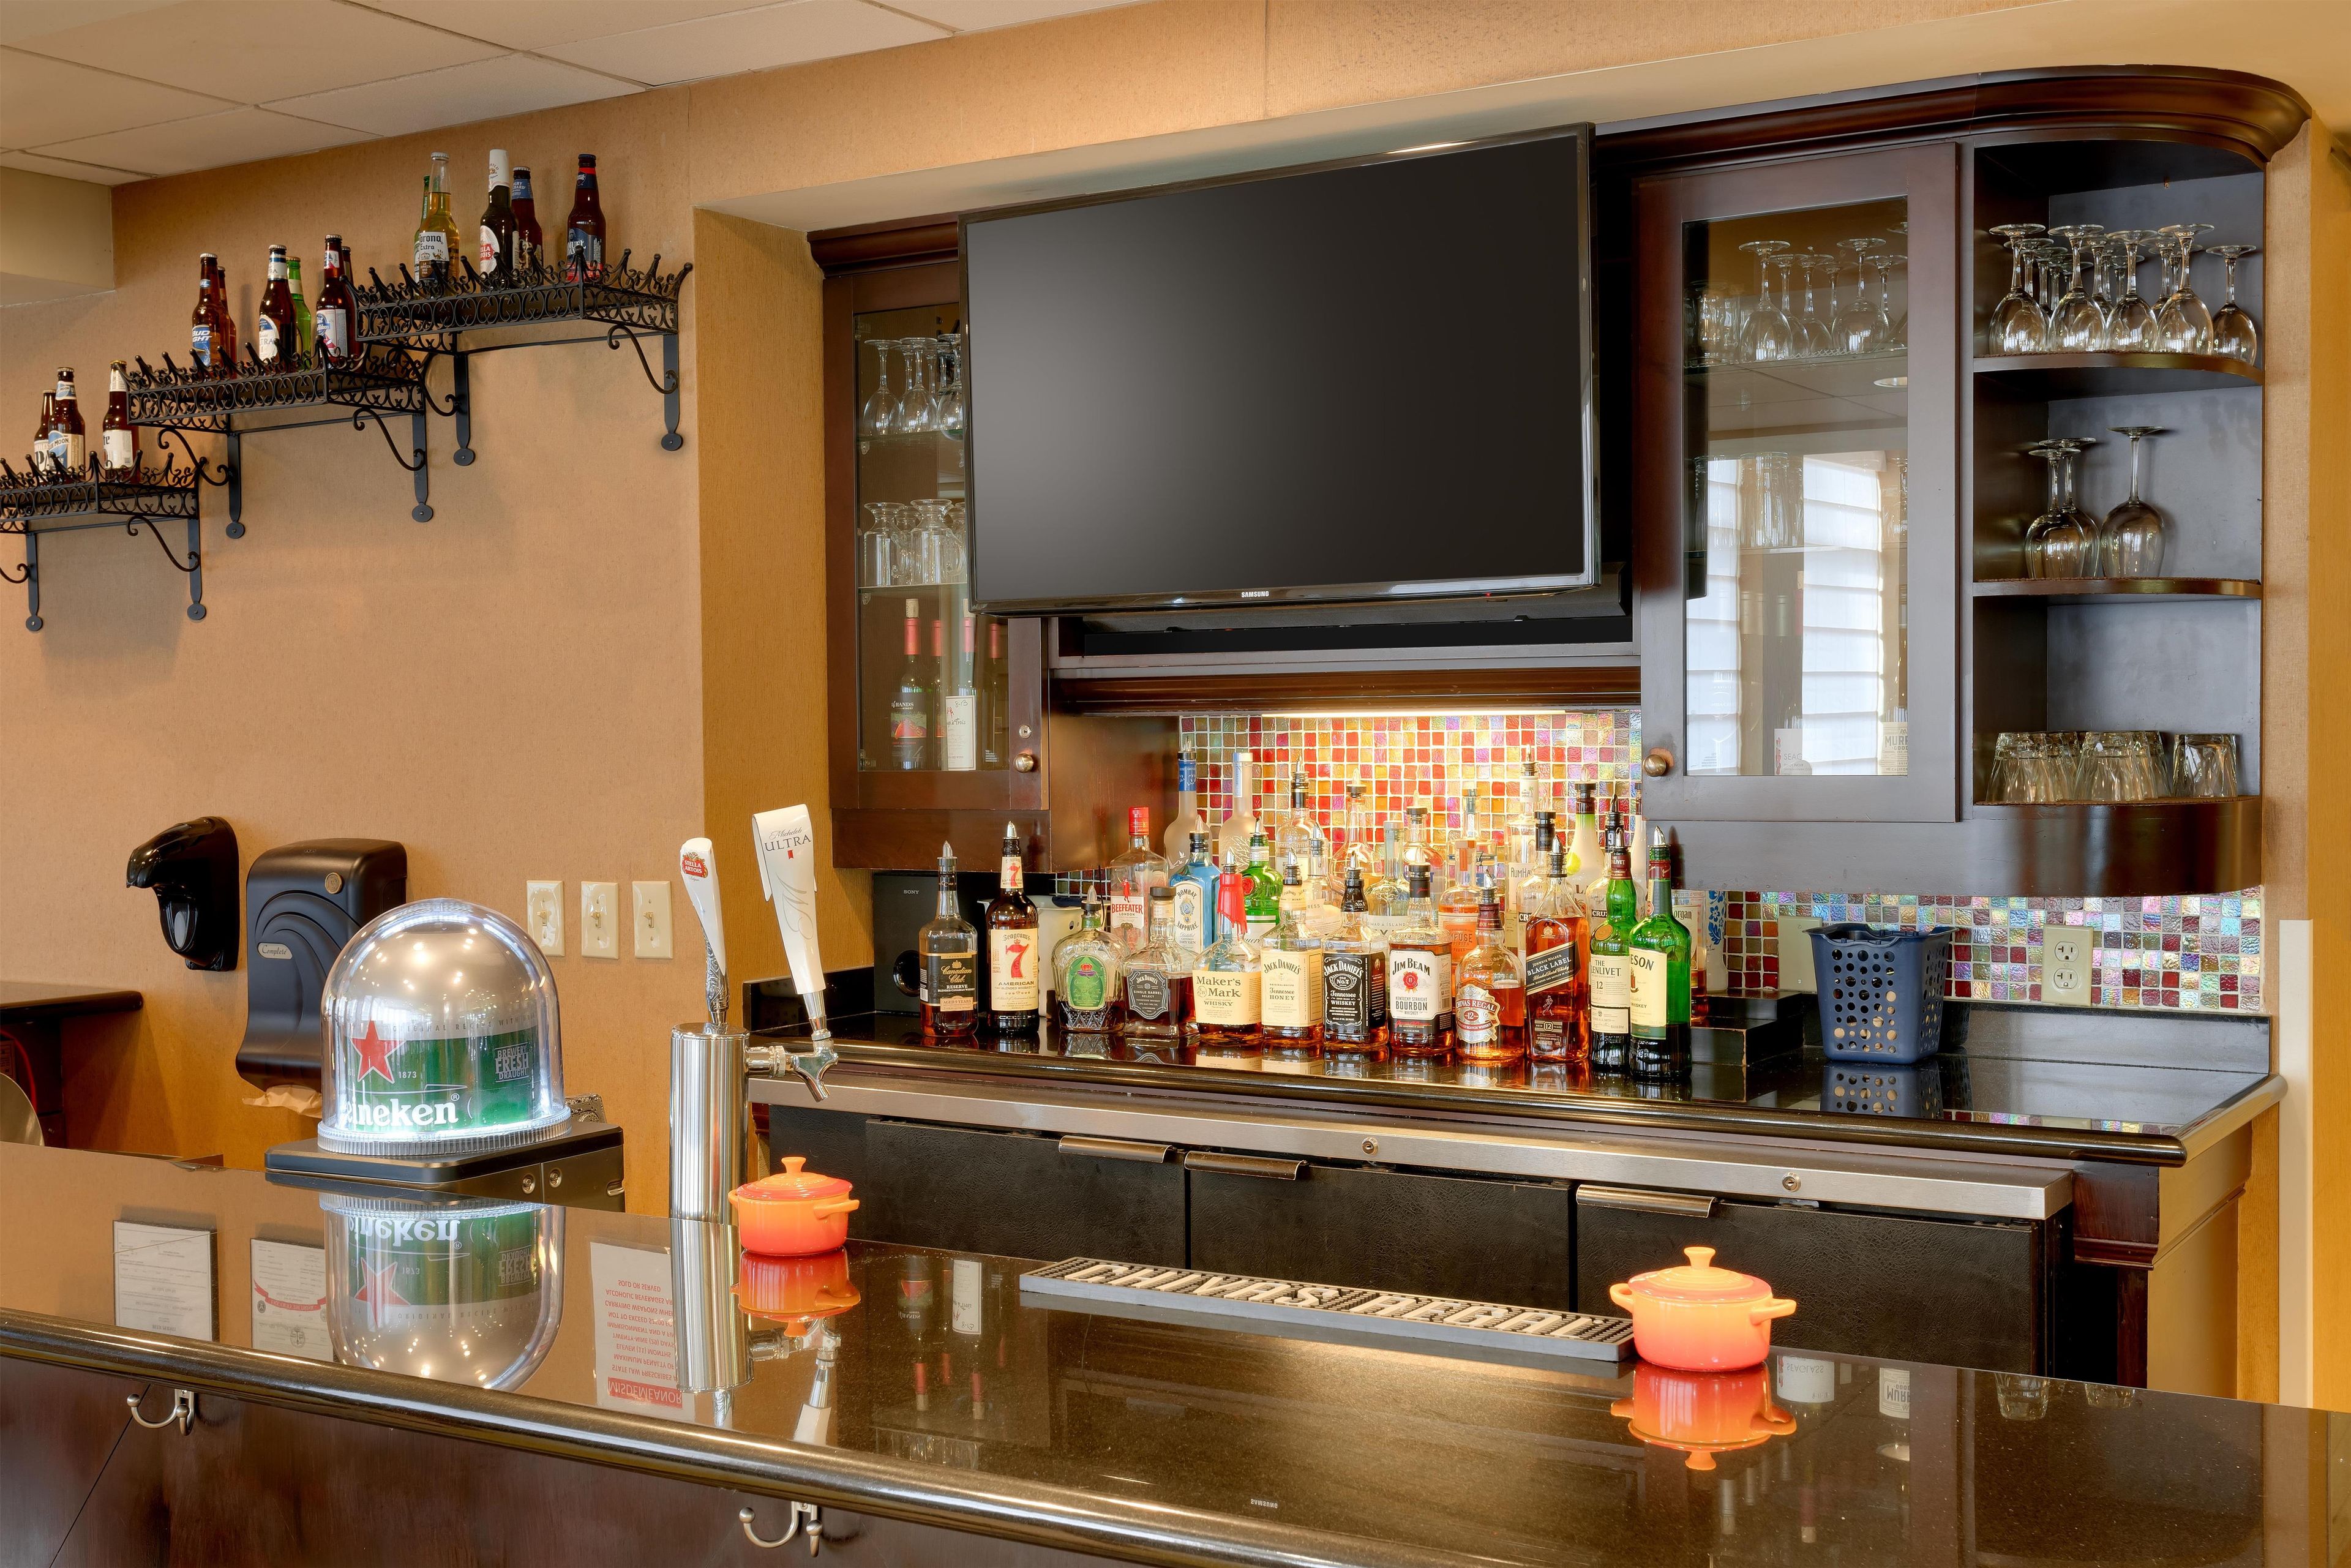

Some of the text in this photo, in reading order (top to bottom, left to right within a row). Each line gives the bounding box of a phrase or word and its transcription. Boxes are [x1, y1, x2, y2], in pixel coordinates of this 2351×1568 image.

[769, 827, 803, 841] Michelob
[764, 835, 811, 852] ULTRA
[684, 866, 703, 874] ARTOIS
[1177, 888, 1198, 899] BOMBAY
[1112, 904, 1143, 914] BEEFEATER
[1673, 910, 1692, 920] organ
[1176, 921, 1199, 931] SAPPHIRE
[261, 945, 287, 956] Complete
[1005, 943, 1029, 978] 7
[1527, 957, 1572, 976] BLACK LABEL
[1532, 959, 1548, 967] JOHNNIE
[941, 966, 973, 975] Canadian
[1264, 959, 1302, 975] JACK DANIEL'S
[1324, 961, 1363, 978] JACK DANIEL'S
[1392, 958, 1431, 976] JIM BEAM
[1196, 976, 1241, 986] Maker's
[1596, 981, 1603, 989] 12
[1209, 988, 1241, 997] Mark
[1396, 1001, 1427, 1010] BOURBON
[1472, 999, 1496, 1011] REGAL
[497, 1045, 528, 1058] BREWERY
[495, 1054, 529, 1074] FRESH
[498, 1068, 528, 1081] DRAUGHT
[1064, 1264, 1340, 1308] CHIVAS
[1349, 1295, 1593, 1338] REGAL
